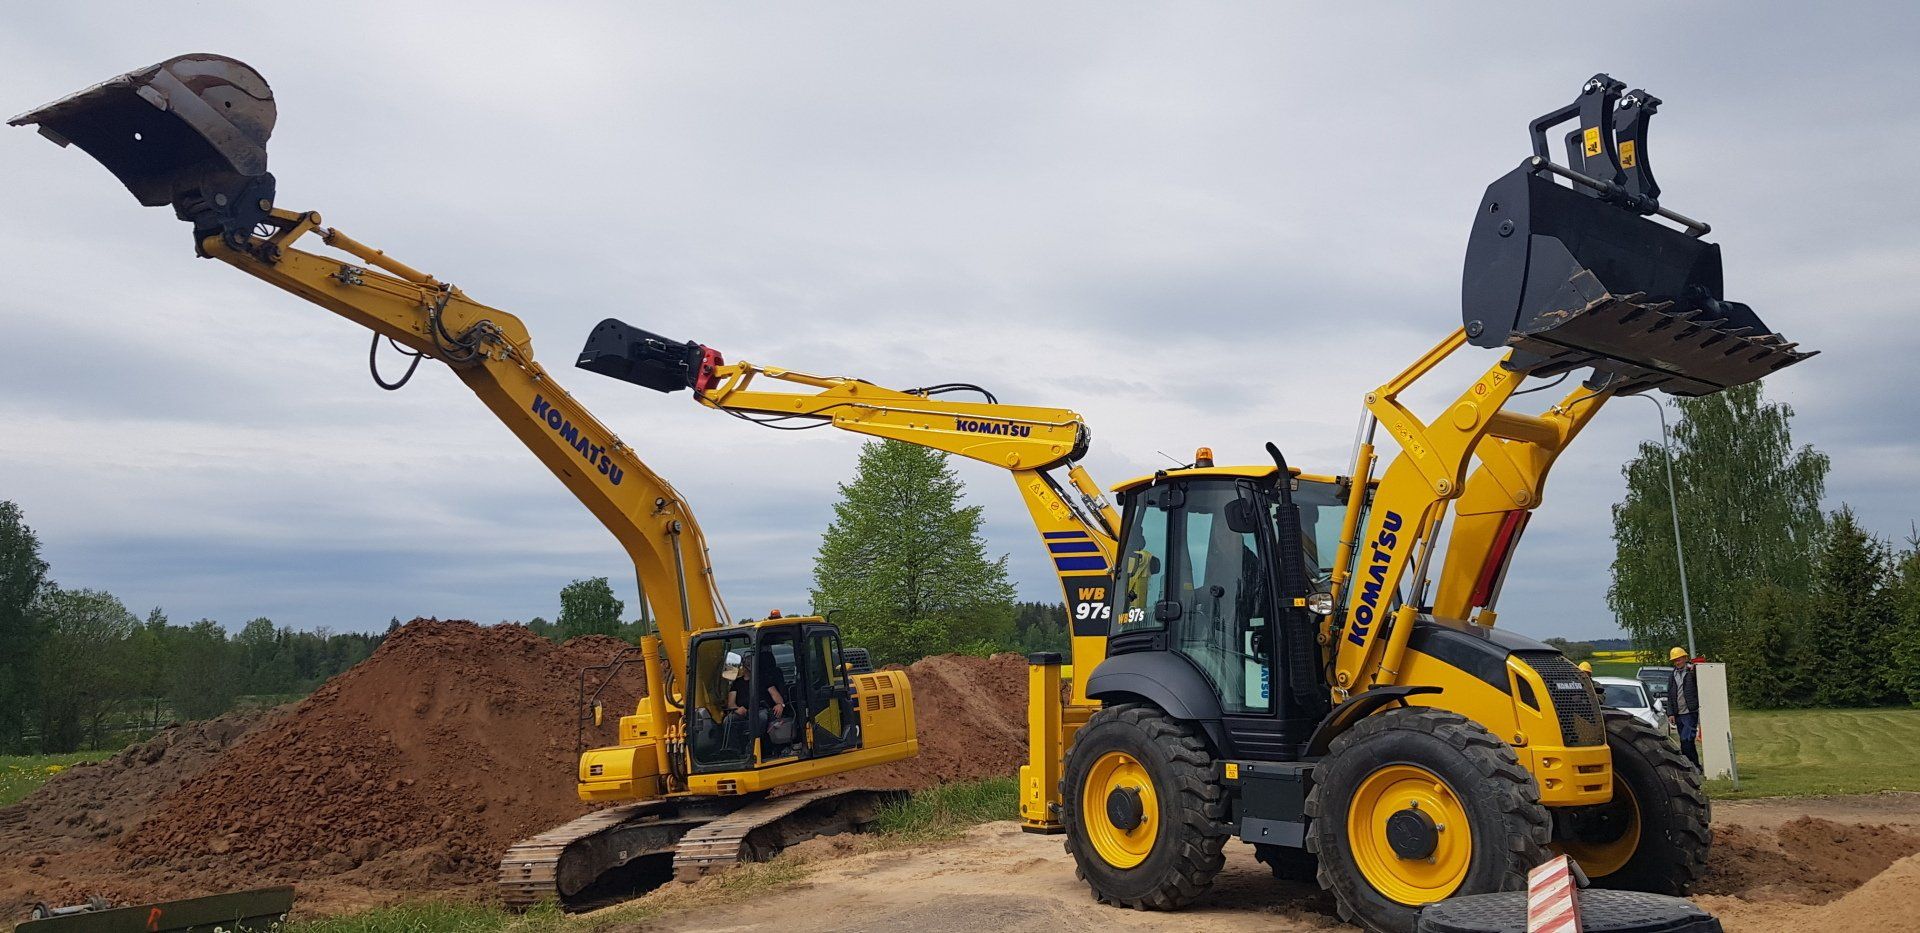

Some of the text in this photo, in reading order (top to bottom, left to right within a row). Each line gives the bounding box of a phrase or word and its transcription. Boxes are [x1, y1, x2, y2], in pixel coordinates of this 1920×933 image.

[956, 420, 1031, 438] KOMATSU
[532, 394, 624, 486] KOMATSU
[1348, 510, 1402, 648] KOMATSU
[1078, 587, 1105, 600] WB
[1075, 602, 1111, 620] 97s
